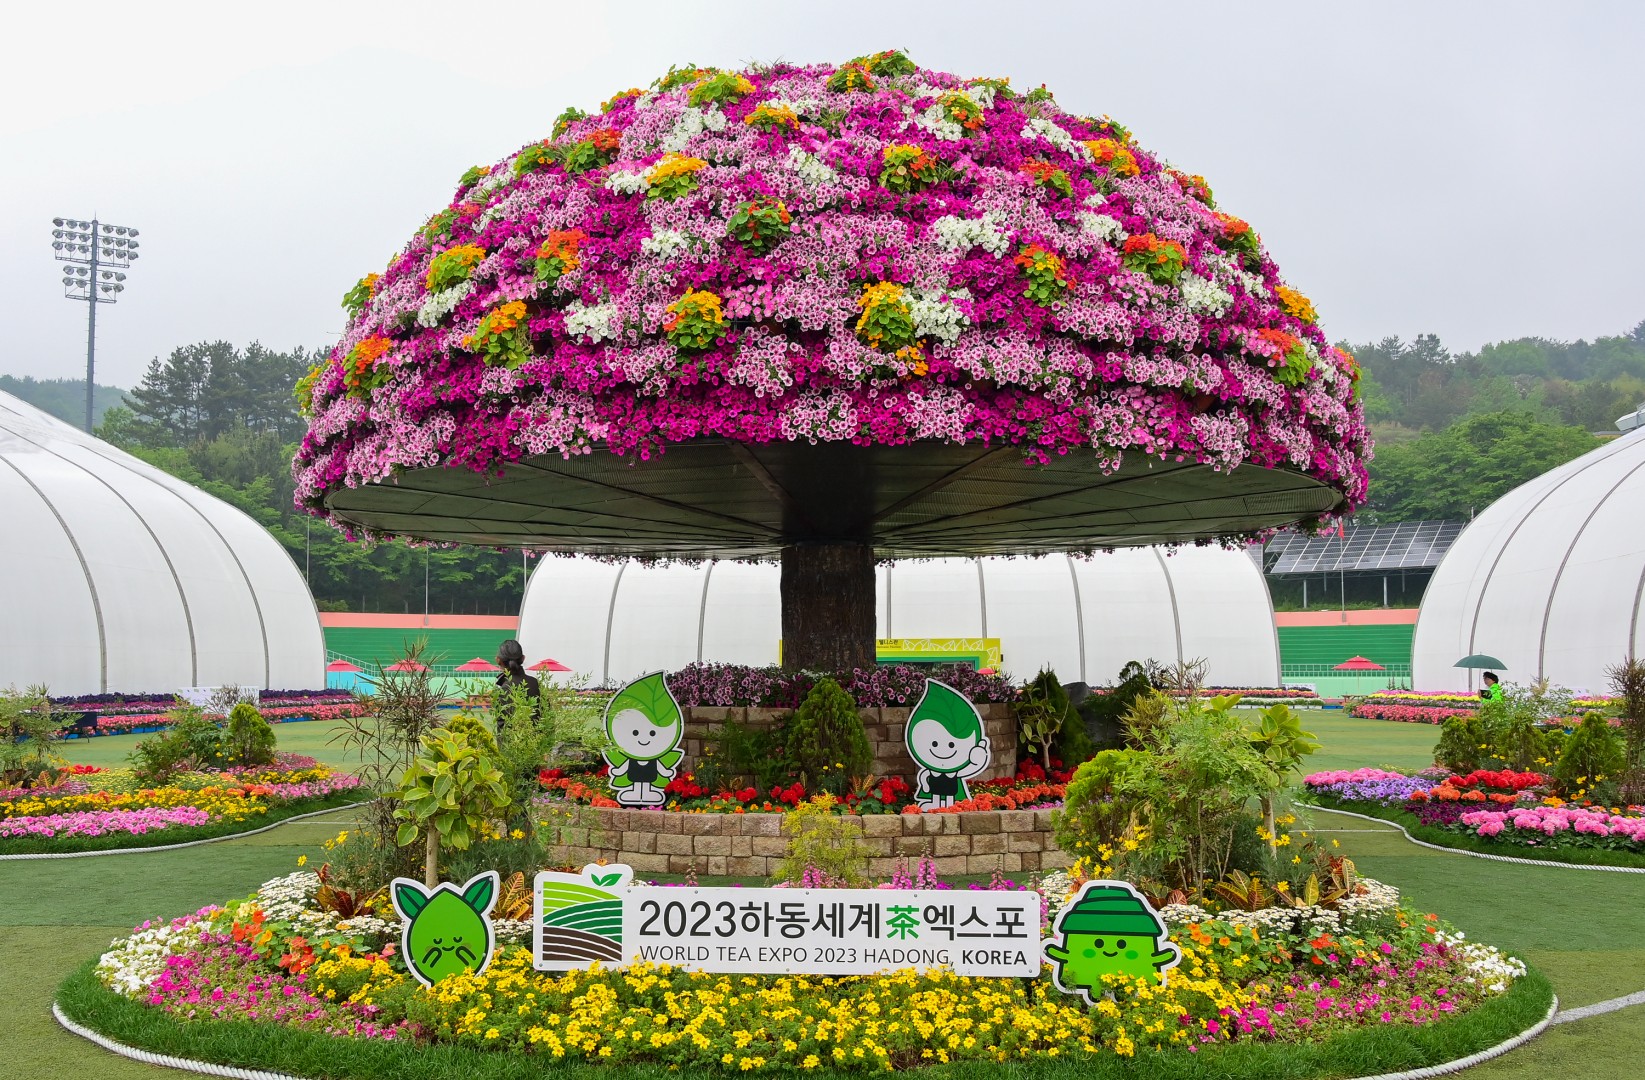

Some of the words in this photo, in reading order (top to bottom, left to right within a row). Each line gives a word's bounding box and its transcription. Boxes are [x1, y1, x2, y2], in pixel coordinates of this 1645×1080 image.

[639, 900, 1028, 941] 2023하동세계茶엑스포
[639, 945, 710, 961] WORLD
[715, 946, 752, 962] TEA
[758, 947, 807, 962] EXPO
[814, 947, 857, 962] 2023
[962, 949, 1027, 965] KOREA
